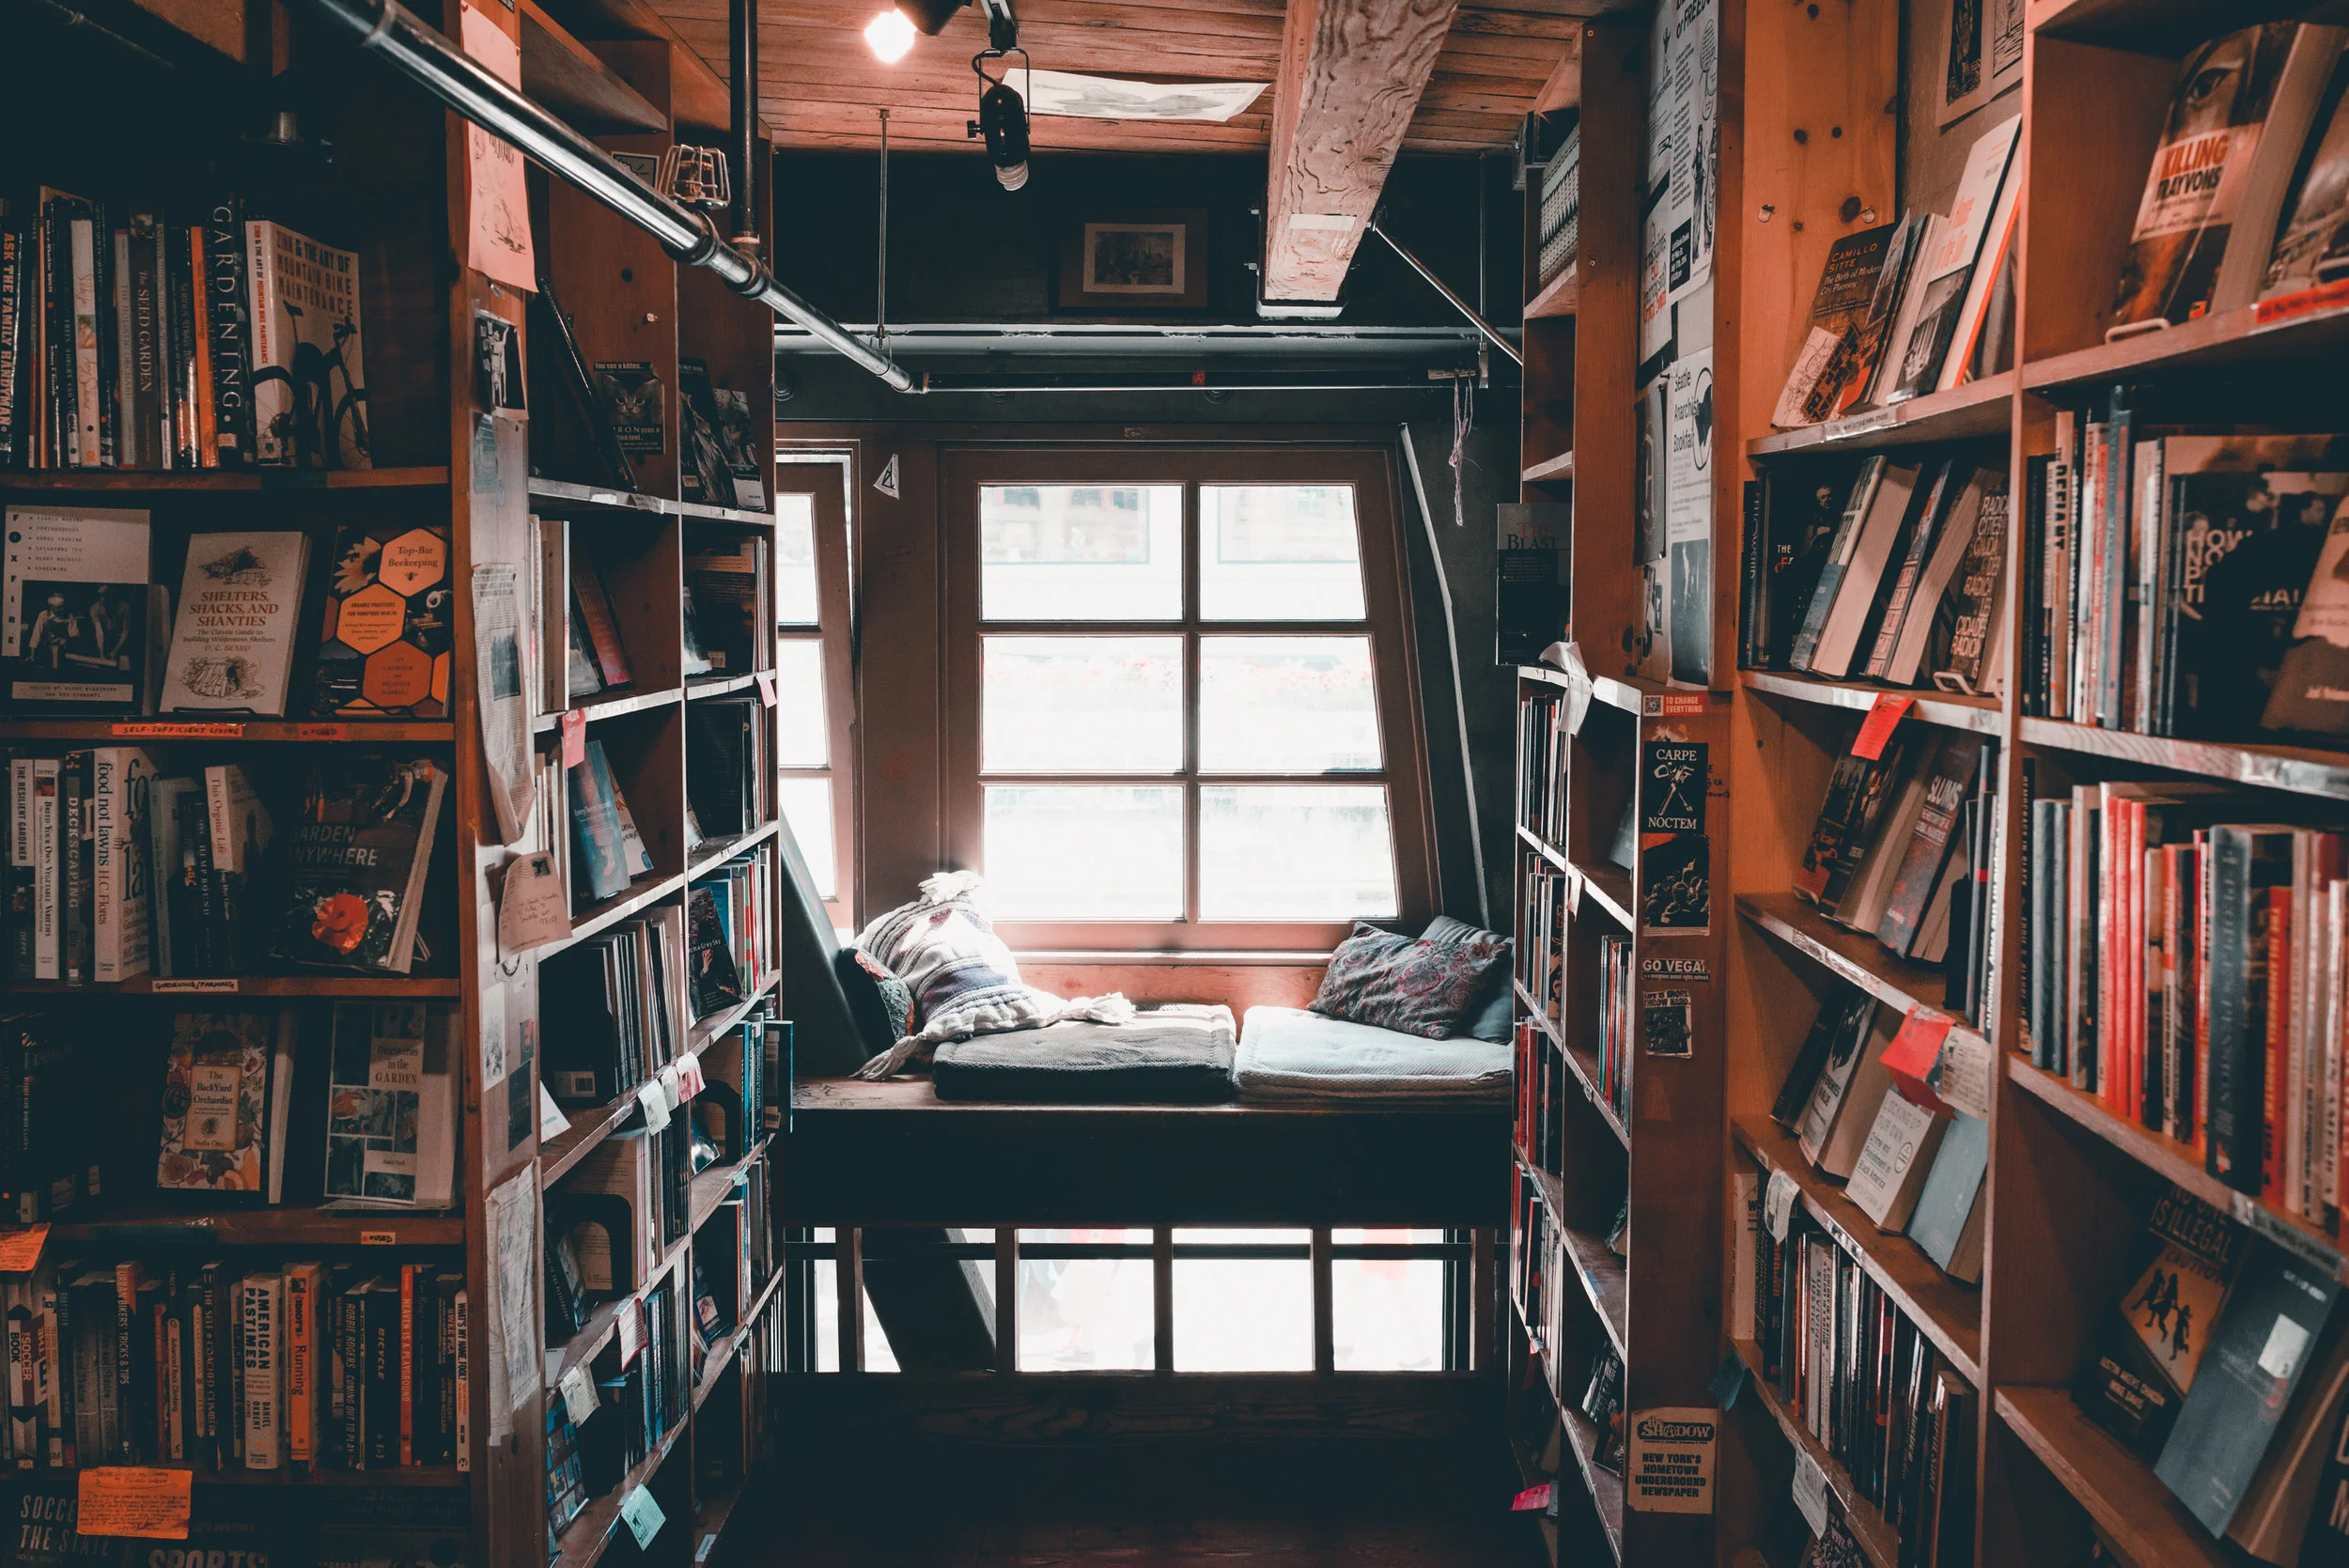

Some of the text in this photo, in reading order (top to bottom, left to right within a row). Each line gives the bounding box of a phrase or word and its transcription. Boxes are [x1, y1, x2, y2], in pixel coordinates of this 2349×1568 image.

[2160, 135, 2230, 181] KILLING
[4, 233, 15, 260] ASK
[304, 241, 318, 264] THE
[319, 249, 334, 271] ART
[338, 255, 351, 274] OF
[1831, 242, 1878, 263] CAMILLO
[256, 259, 264, 271] ART
[1824, 264, 1883, 286] The Birth of Modern
[1828, 258, 1857, 273] SITTE
[3, 265, 14, 292] THE
[325, 272, 353, 296] BIKE
[1820, 281, 1858, 296] City Planning
[137, 288, 150, 327] SEED
[212, 206, 241, 409] GARDENING
[278, 275, 354, 318] MAINTENANCE
[1, 297, 13, 345] FAMILY
[139, 331, 152, 393] GARDEN
[1674, 368, 1691, 393] Seattle
[1674, 397, 1700, 423] Anarchist
[1673, 429, 1695, 453] Bookfair
[1982, 495, 2009, 516] RADIC
[2054, 463, 2067, 551] DEFIANT
[397, 546, 434, 556] Top-Bar
[1507, 535, 1560, 550] BLAST
[1777, 545, 1792, 554] THE
[388, 558, 439, 568] Beekeeping
[188, 603, 279, 614] SHACKS, AND
[201, 591, 270, 602] SHELTERS,
[196, 615, 267, 627] SHANTIES
[1665, 696, 1699, 705] TO CHANGE
[1666, 705, 1703, 713] EVERYTHING
[123, 726, 240, 736] SELF-SUFFICIENT LIVING
[1656, 749, 1697, 761] CARPE
[97, 762, 113, 795] food
[1927, 775, 1964, 812] SLUMS
[17, 766, 27, 862] THE RESILIENT GARDENER
[98, 799, 112, 821] not
[210, 778, 227, 854] This Organic Life
[1648, 816, 1697, 830] NOCTEM
[69, 797, 79, 909] DECKSCAPING
[98, 825, 114, 866] lawns
[98, 894, 110, 925] Flores
[700, 941, 712, 950] Grey
[1642, 959, 1662, 971] GO
[209, 1070, 224, 1079] The
[387, 1060, 409, 1070] in the
[375, 1072, 418, 1085] GARDEN
[194, 1094, 233, 1104] Orchardist
[2150, 1196, 2232, 1264] IS ILLEGAL
[117, 1270, 129, 1297] URBAN
[403, 1297, 412, 1329] HEAVEN
[458, 1302, 468, 1327] WHAT'S
[244, 1287, 257, 1369] PASTIMES
[257, 1288, 271, 1370] AMERICAN
[402, 1331, 412, 1340] IS
[459, 1328, 468, 1340] MY
[10, 1331, 22, 1363] BOOK
[118, 1332, 130, 1358] TRICKS
[21, 1337, 33, 1381] SOCCER
[203, 1288, 217, 1432] THE SELF COACHED CLIMBER
[291, 1344, 306, 1395] Running
[459, 1361, 468, 1381] FOOL?
[119, 1369, 130, 1385] TIPS
[170, 1337, 180, 1413] Advanced Rock Climbing
[346, 1302, 355, 1452] ROBBIE ROGERS COMING OUT TO PLAY
[400, 1351, 411, 1402] PLAYGROUND
[253, 1400, 261, 1430] OKRENT
[261, 1401, 272, 1428] DANIEL
[1642, 1453, 1702, 1464] NEW YORK'S
[1643, 1465, 1699, 1475] HOMETOWN
[1635, 1475, 1706, 1486] UNDERGROUND
[1641, 1486, 1700, 1498] NEWSPAPER
[20, 1494, 78, 1523] SOCCE
[20, 1524, 54, 1551] THE
